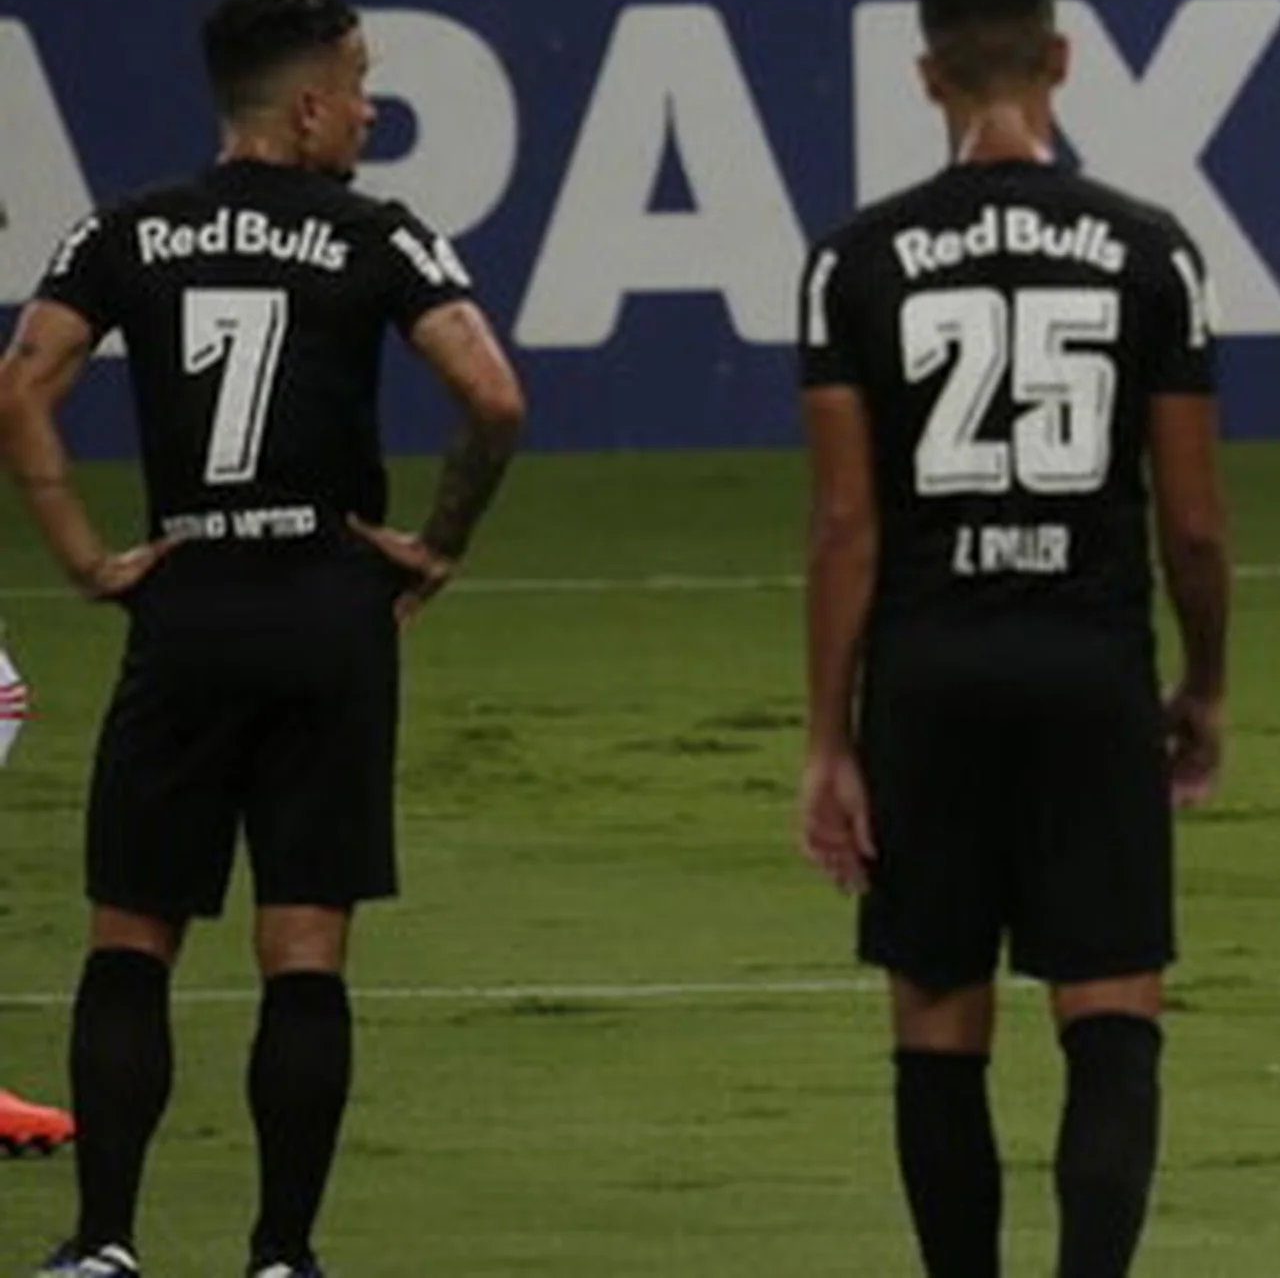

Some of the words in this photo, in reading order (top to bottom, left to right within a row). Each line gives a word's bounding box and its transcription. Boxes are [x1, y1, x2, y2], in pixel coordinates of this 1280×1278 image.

[136, 208, 228, 266] Red
[235, 211, 350, 272] Bulls
[894, 205, 997, 278] Red
[1004, 207, 1127, 273] Bulls
[182, 288, 288, 486] 7
[900, 287, 1119, 496] 25
